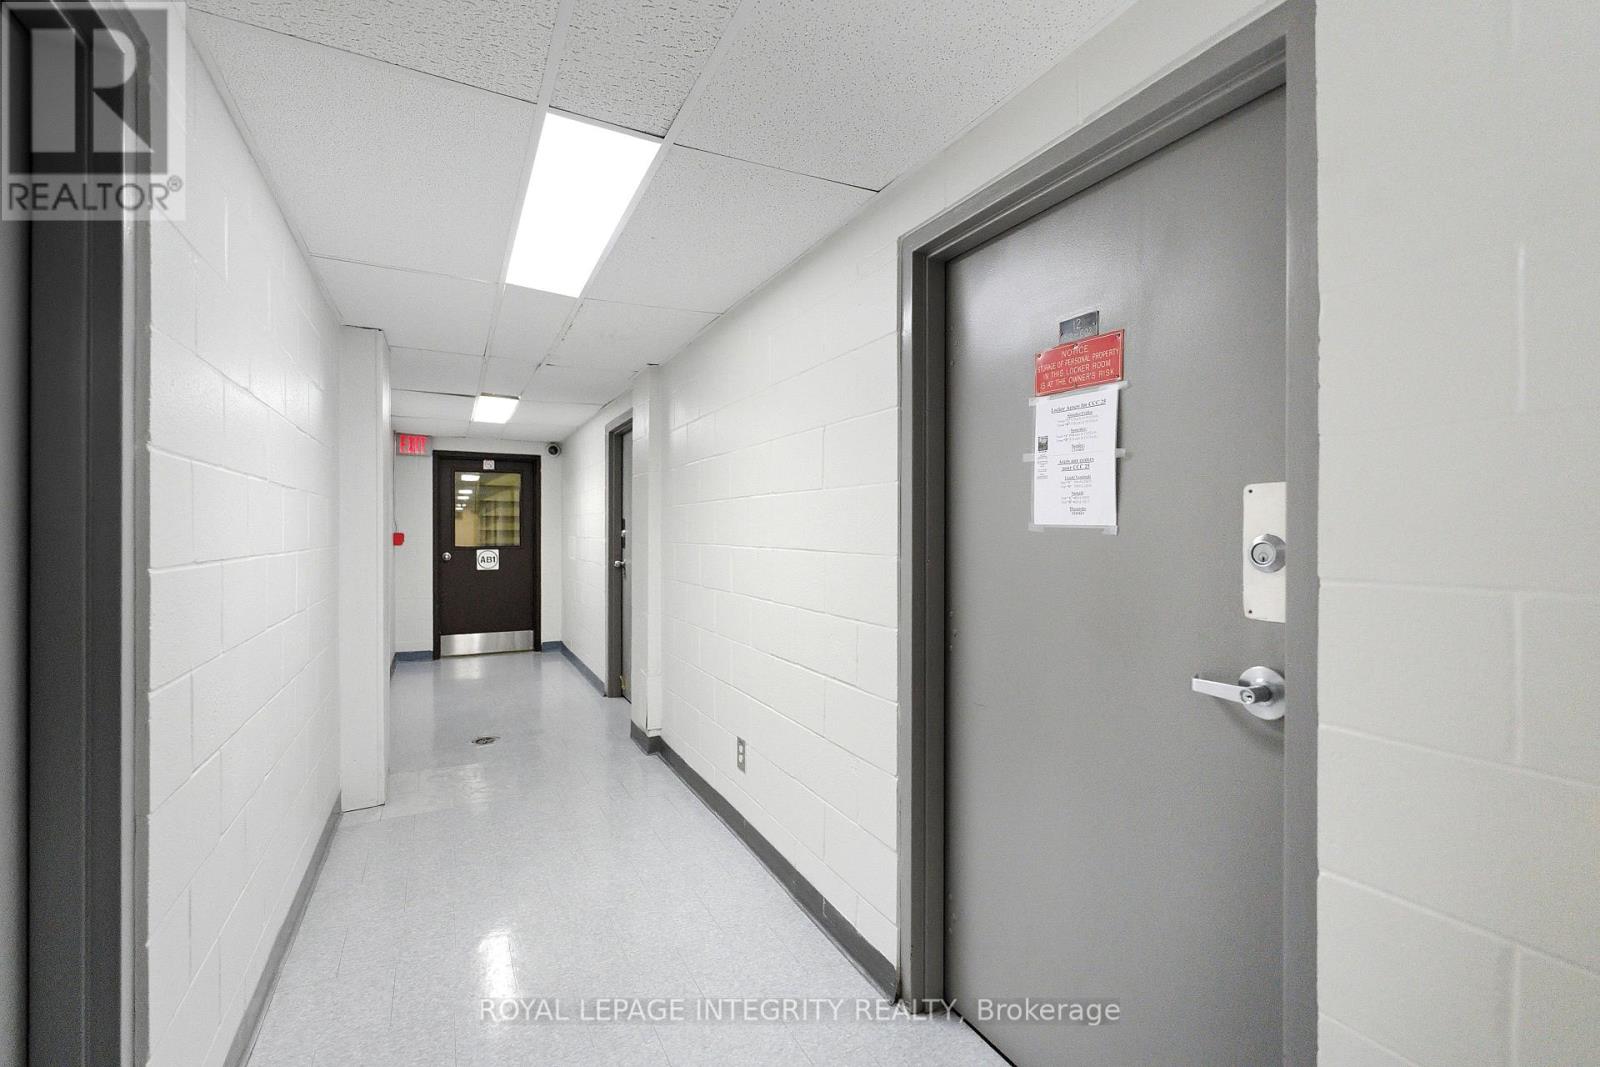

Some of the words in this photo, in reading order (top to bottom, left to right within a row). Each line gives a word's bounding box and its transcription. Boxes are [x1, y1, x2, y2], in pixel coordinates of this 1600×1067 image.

[1061, 344, 1089, 358] NOTICE
[1064, 354, 1090, 368] PERSONAL
[1092, 348, 1119, 361] PROPERTY
[1051, 369, 1064, 378] THIS
[1066, 363, 1090, 376] LOCKER
[1092, 359, 1111, 370] ROOM
[1068, 372, 1096, 385] OWNER'S
[1098, 369, 1114, 380] RISK
[399, 434, 428, 454] EXIT
[480, 556, 496, 564] AB1
